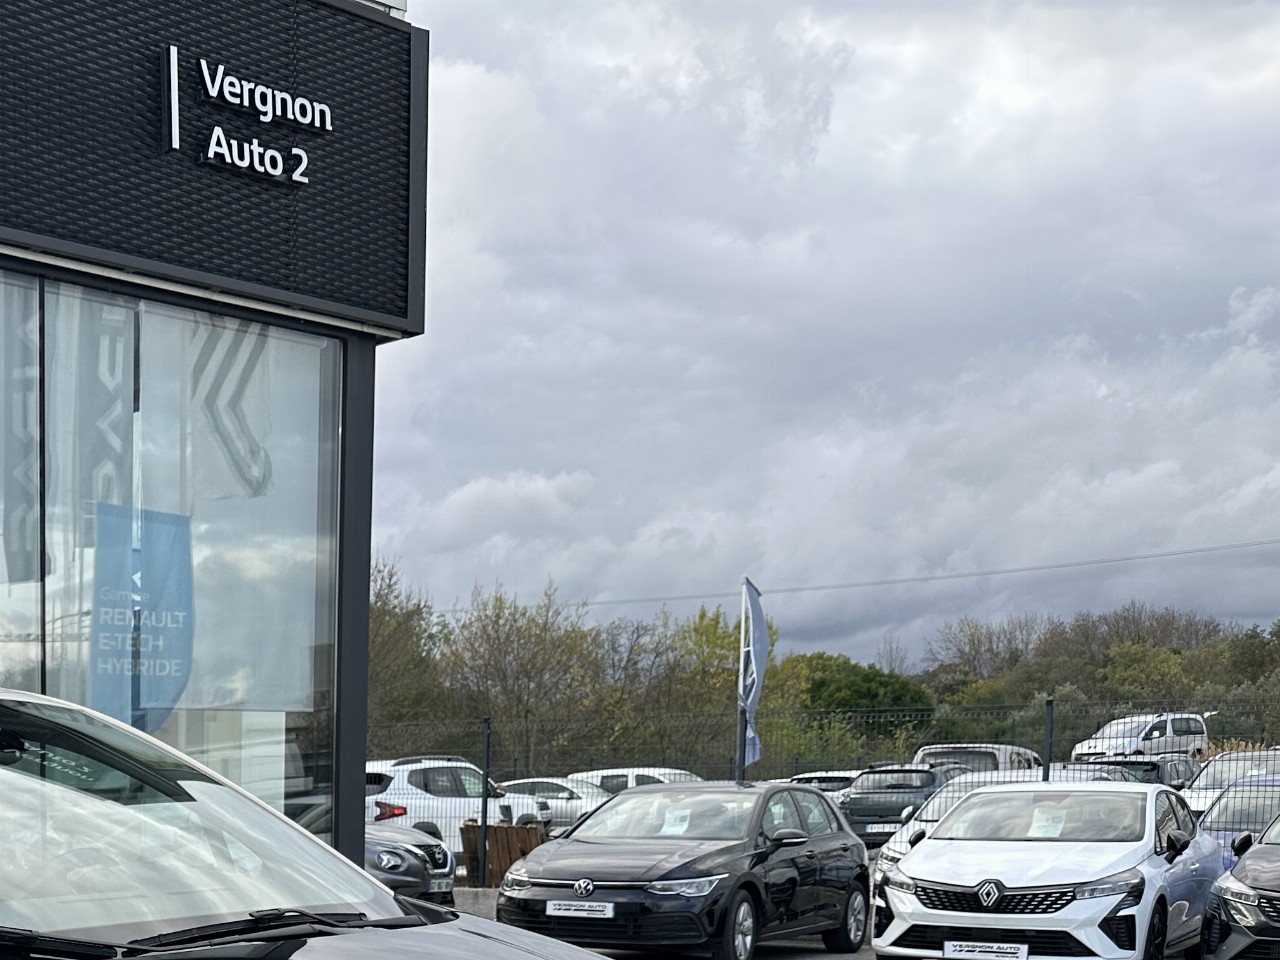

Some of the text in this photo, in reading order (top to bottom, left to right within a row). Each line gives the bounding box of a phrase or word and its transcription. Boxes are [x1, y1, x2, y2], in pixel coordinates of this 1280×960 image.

[199, 58, 333, 131] Vergnon
[207, 125, 309, 184] Auto 2
[99, 608, 188, 628] RENAULT
[98, 632, 164, 652] E-TECH
[96, 658, 183, 677] HYBRIDE
